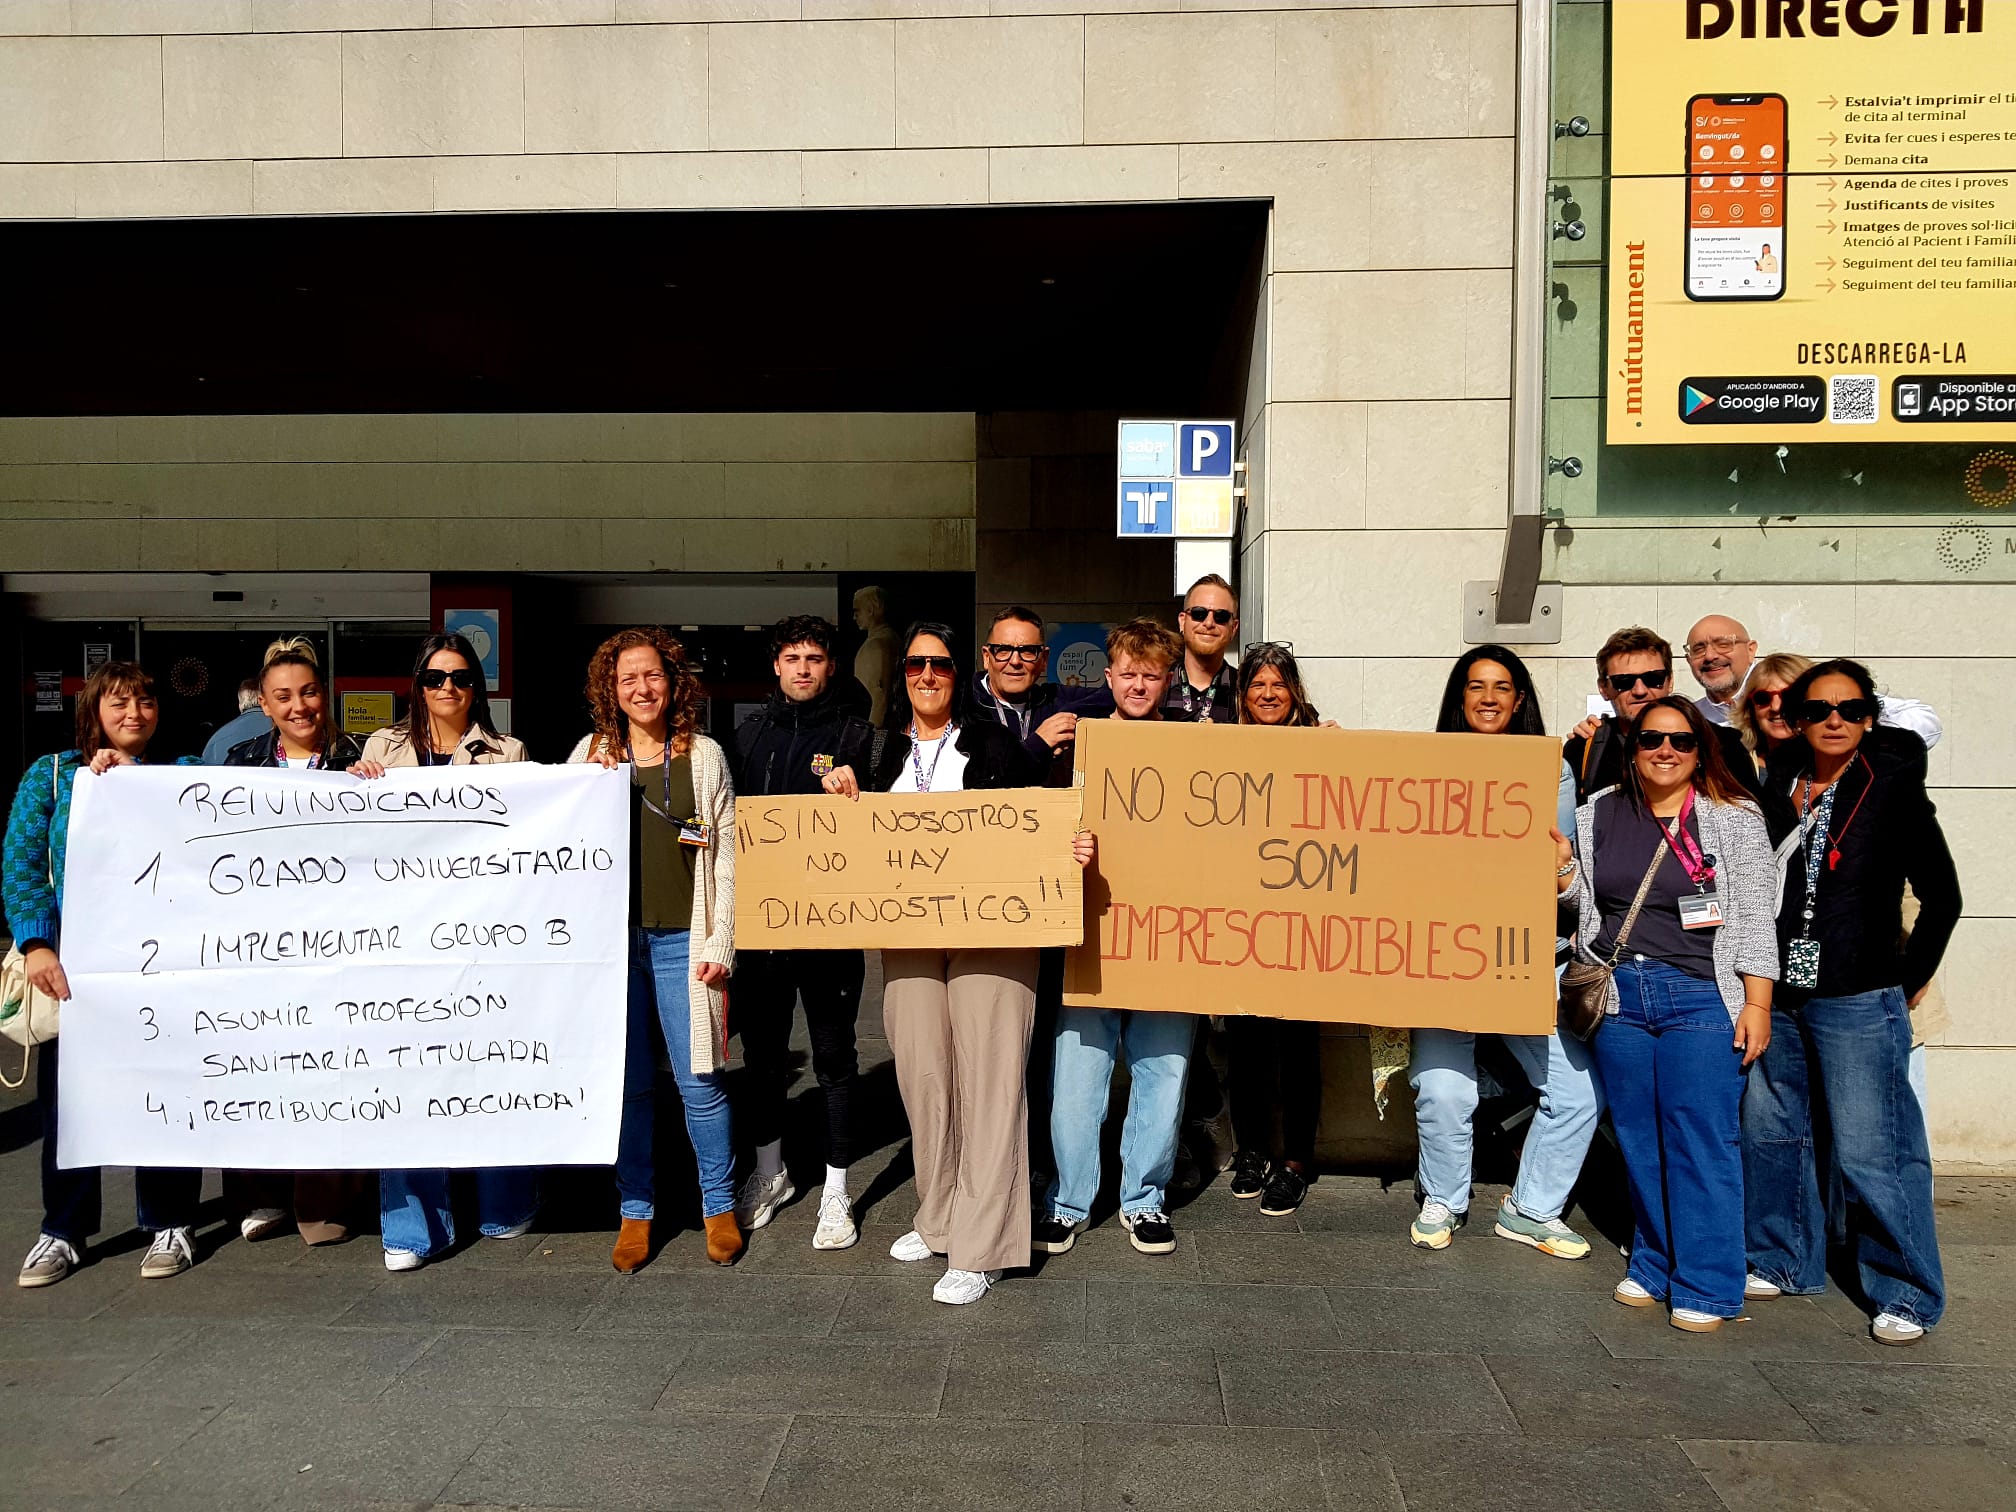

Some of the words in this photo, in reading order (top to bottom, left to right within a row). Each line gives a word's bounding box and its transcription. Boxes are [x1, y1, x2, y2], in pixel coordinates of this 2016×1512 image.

[1845, 96, 1912, 107] Estalvia't
[1916, 94, 1986, 108] imprimir
[1989, 93, 2001, 104] el
[1844, 112, 1861, 122] de
[1864, 111, 1888, 122] cita
[1891, 111, 1904, 122] al
[1907, 110, 1967, 121] terminal
[1844, 133, 1881, 144] Evita
[1885, 132, 1903, 143] fer
[1906, 133, 1938, 143] cues
[1949, 132, 2001, 145] esperes
[1844, 154, 1898, 165] Demana
[1901, 153, 1929, 165] cita
[1844, 178, 1897, 191] Agenda
[1900, 178, 1917, 189] de
[1919, 177, 1952, 188] cites
[1962, 178, 2009, 190] proves
[1843, 199, 1929, 211] Justificants
[1931, 199, 1948, 210] de
[1951, 199, 1995, 209] visites
[1843, 221, 1900, 234] Imatges
[1903, 221, 1920, 232] de
[1923, 222, 1968, 234] proves
[1843, 236, 1894, 247] Atenció
[1897, 236, 1909, 247] al
[1913, 235, 1962, 247] Pacient
[1842, 257, 1913, 270] Seguiment
[1917, 257, 1937, 268] del
[1940, 258, 1962, 268] teu
[1842, 279, 1913, 292] Seguiment
[1916, 279, 1936, 290] del
[1940, 279, 1962, 289] teu
[1618, 240, 1645, 415] mútuament
[1797, 342, 1967, 364] DESCARREGA-LA
[1727, 382, 1761, 390] APLICACIÓ
[1939, 382, 2005, 395] Disponible
[1718, 394, 1780, 413] Google
[1784, 394, 1820, 412] Play
[1928, 396, 1970, 417] App
[1975, 396, 2016, 412] Stor
[1192, 429, 1219, 472] P
[178, 782, 508, 823] REIVINDICAMOS
[1102, 766, 1165, 822] NO
[1184, 770, 1274, 828] SOM
[1290, 772, 1534, 840] INVISIBLES
[872, 803, 1040, 833] NOSOTROS
[209, 853, 346, 895] GRADO
[374, 838, 614, 882] UNIVERSITARIO
[806, 852, 847, 872] NO
[885, 847, 950, 874] HAY
[1258, 838, 1359, 895] SOM
[200, 925, 402, 967] IMPLEMENTAR
[430, 922, 527, 950] GRUPO
[544, 918, 572, 945] B
[194, 1002, 313, 1035] ASUMIR
[334, 980, 508, 1025] PROFESIÓN
[202, 1045, 370, 1078] SANITARIA
[388, 1039, 549, 1068] TITULADA
[427, 1087, 587, 1121] ADECUADA!
